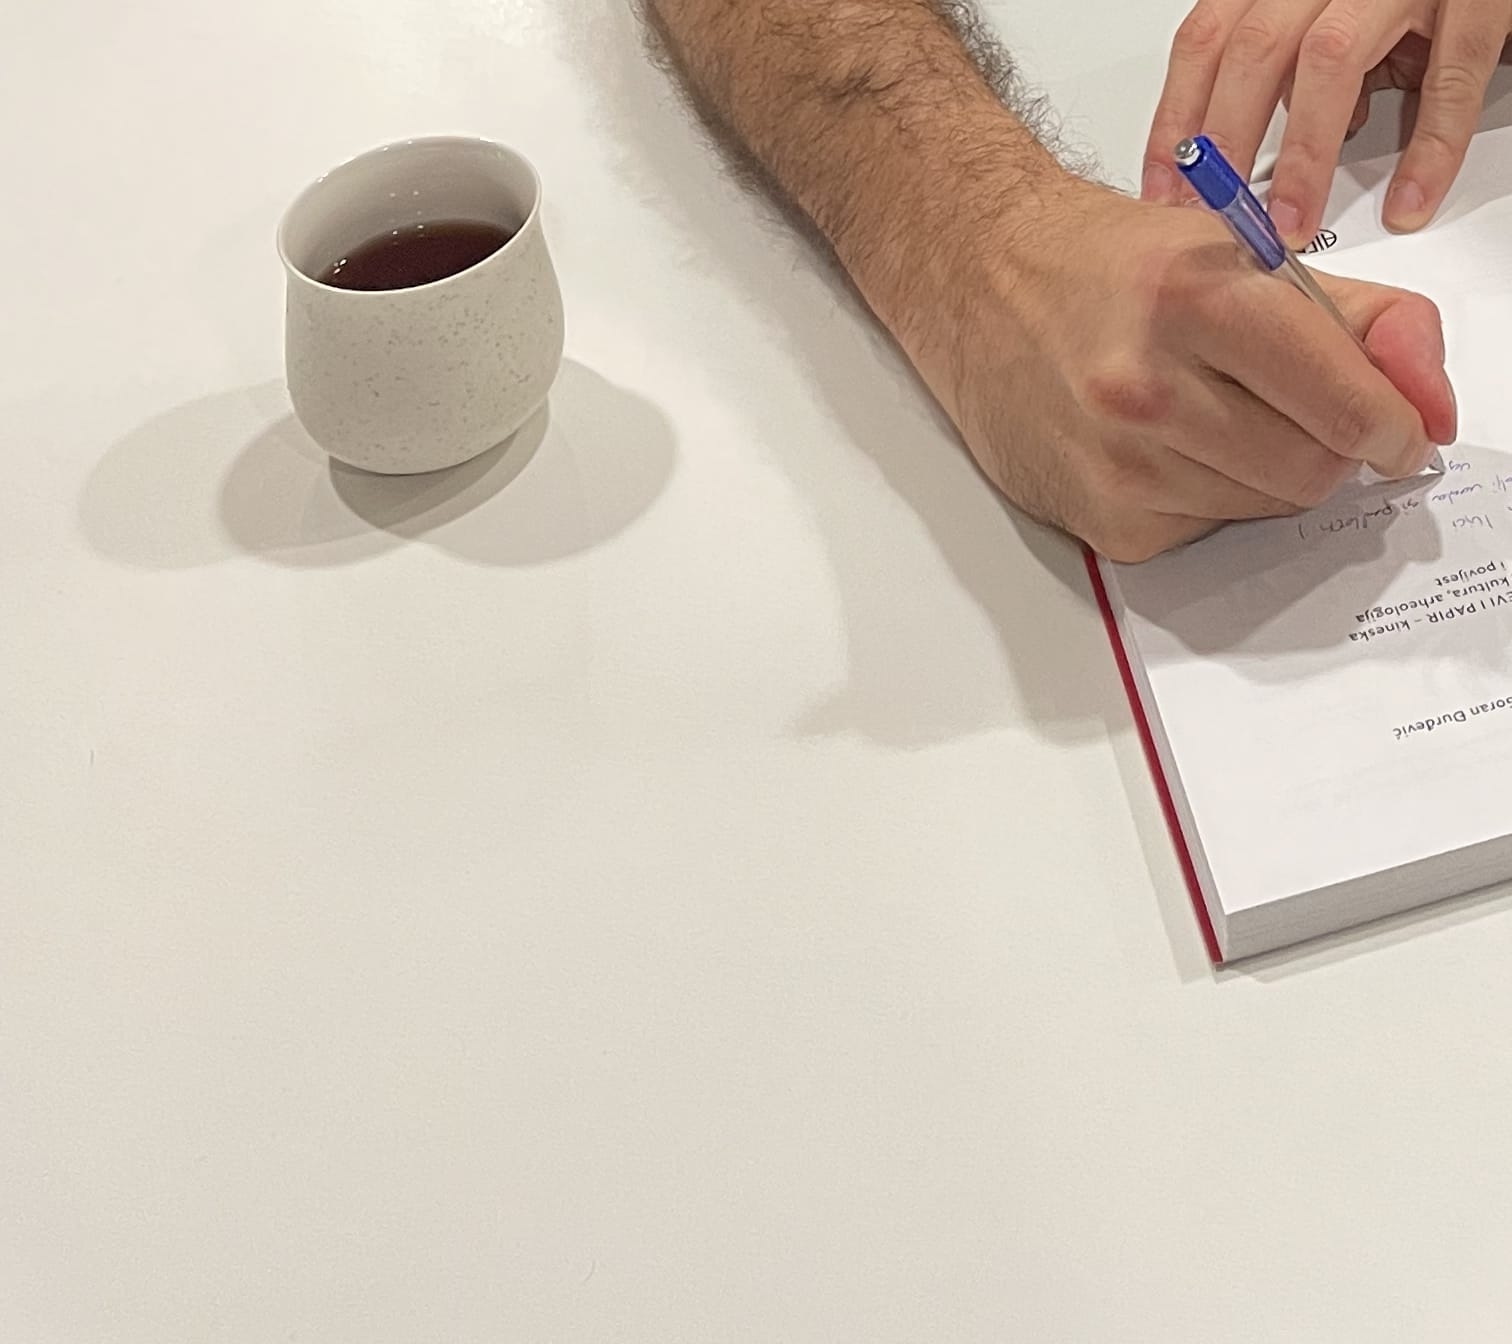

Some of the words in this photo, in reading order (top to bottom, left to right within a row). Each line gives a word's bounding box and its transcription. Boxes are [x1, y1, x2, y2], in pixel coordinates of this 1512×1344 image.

[1434, 560, 1497, 587] povijest
[1446, 576, 1510, 598] kultura,
[1355, 593, 1444, 623] arheologija
[1425, 602, 1477, 624] PAPIR
[1347, 619, 1411, 642] kineska
[1392, 710, 1467, 741] Đurđević
